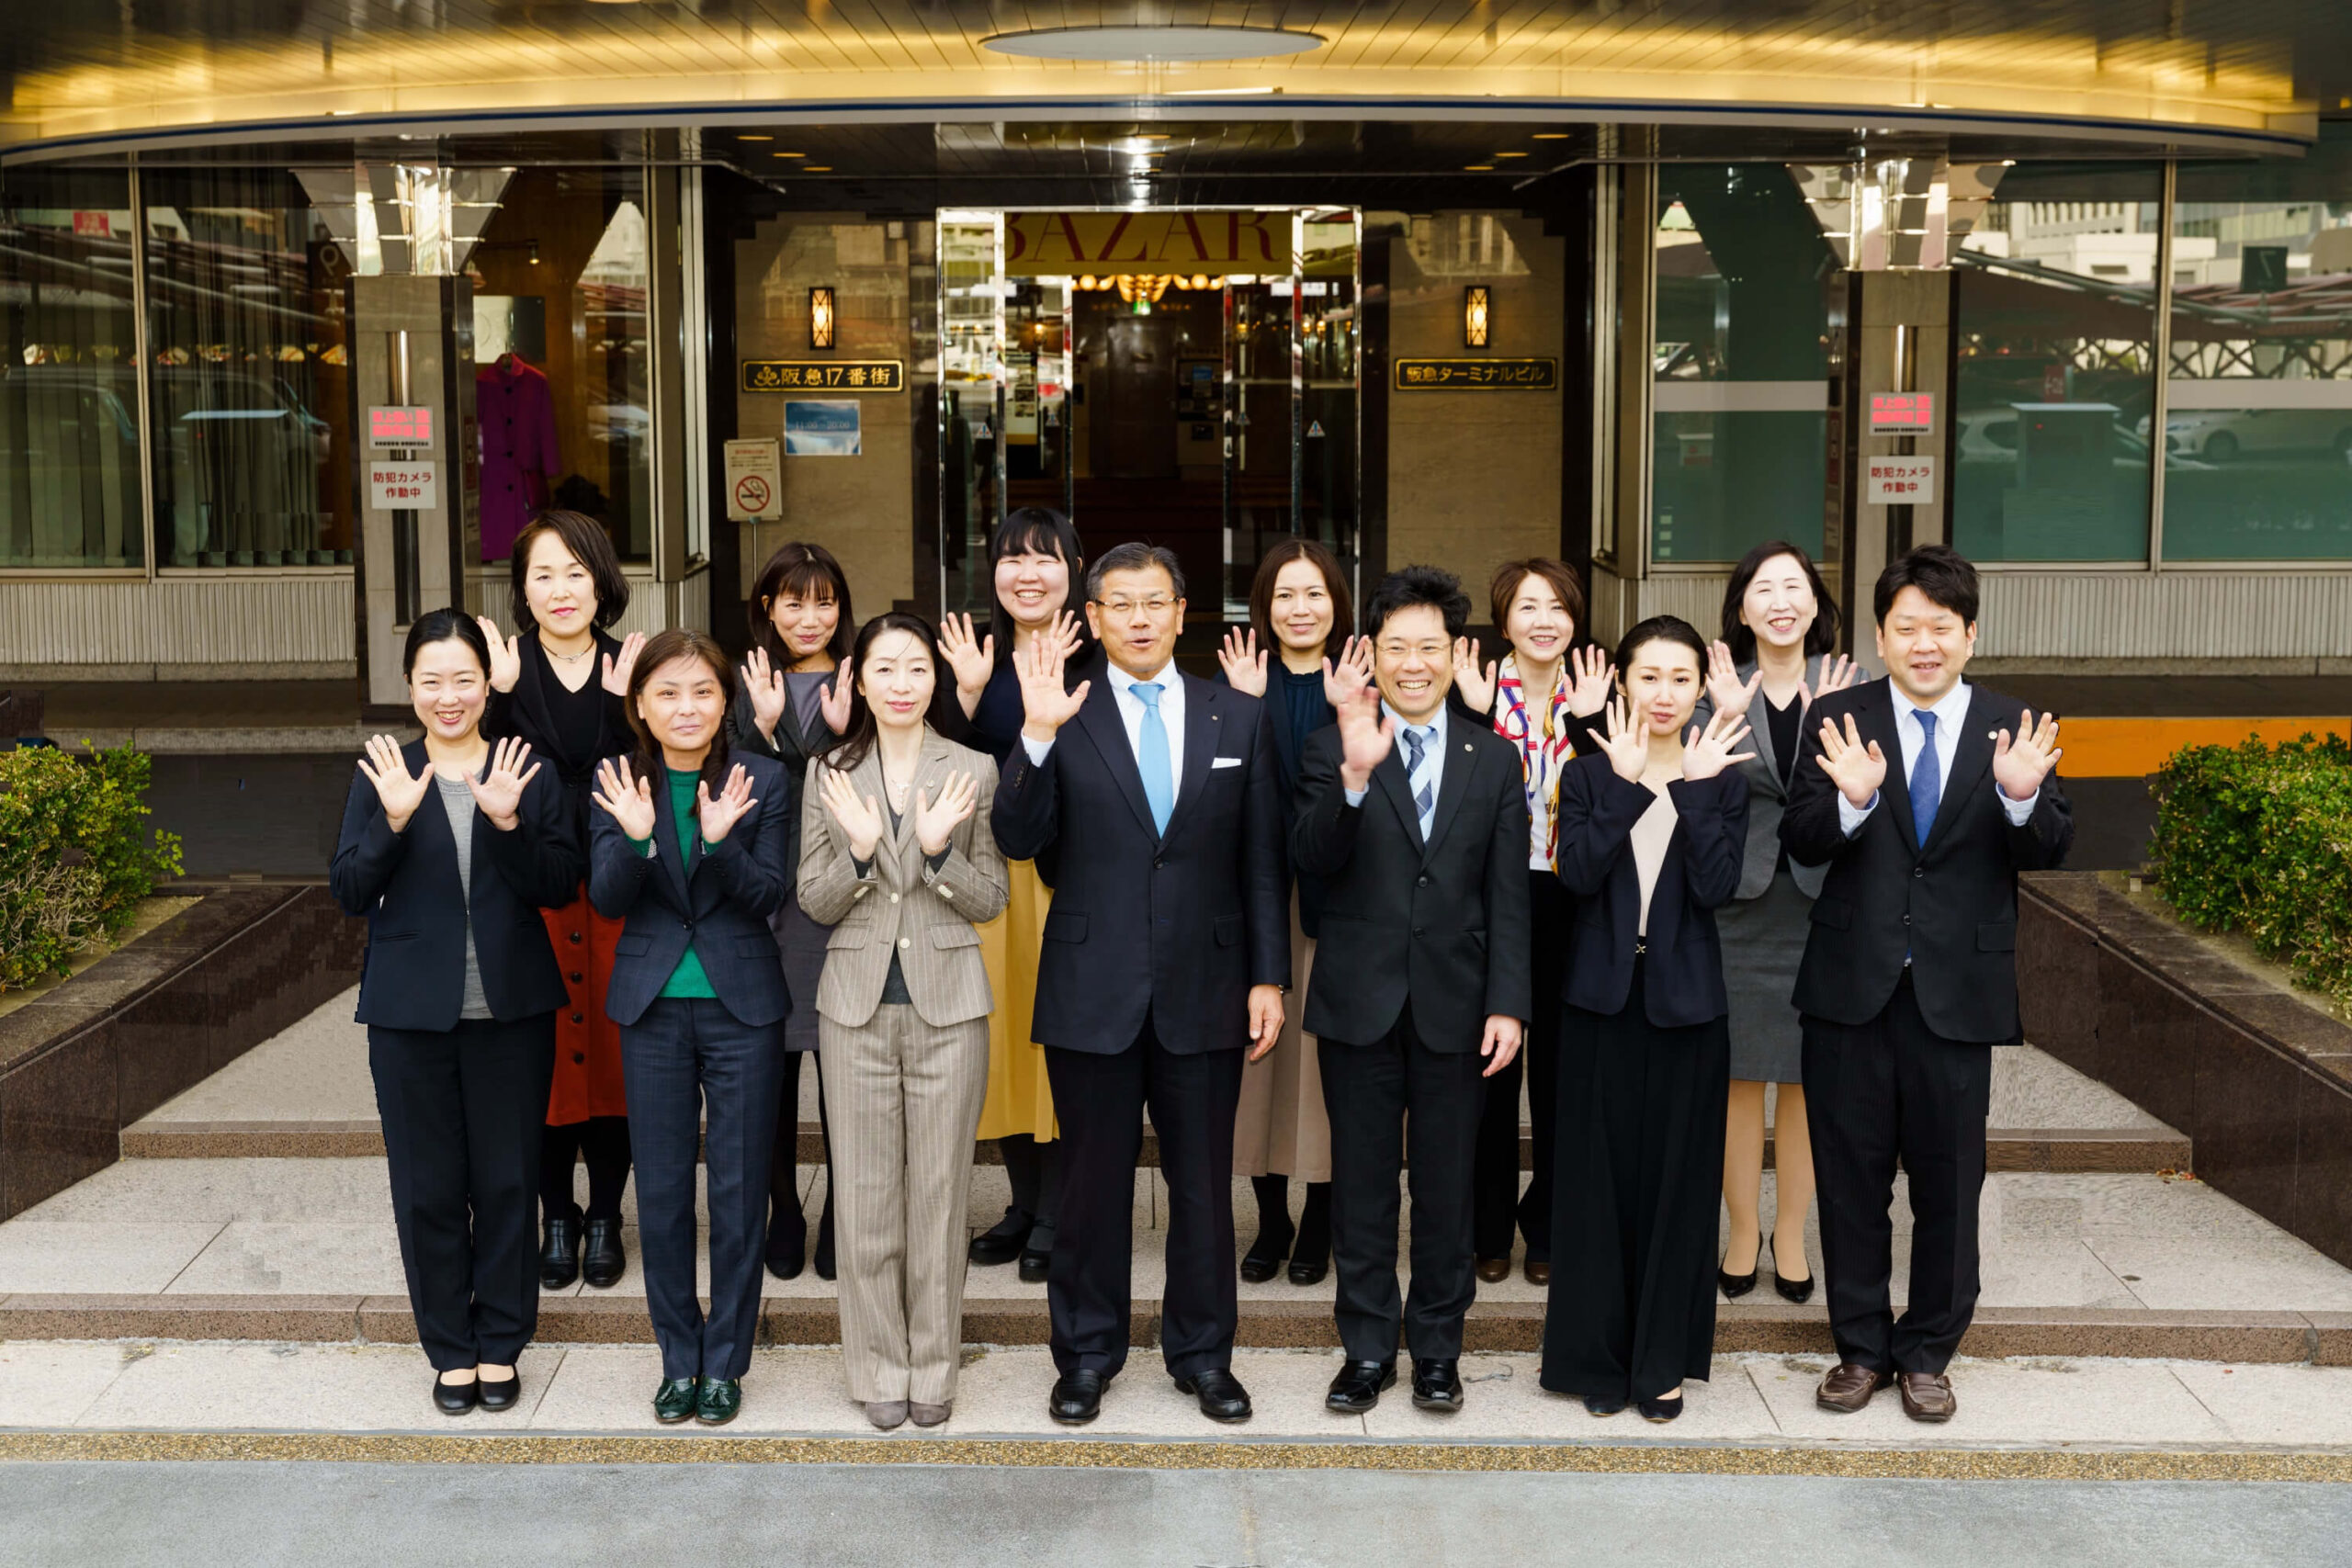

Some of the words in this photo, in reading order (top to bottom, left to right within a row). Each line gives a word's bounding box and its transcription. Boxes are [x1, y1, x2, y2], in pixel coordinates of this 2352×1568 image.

[781, 367, 891, 387] 阪急17番街
[1406, 366, 1545, 383] 阪急ターミナルビル
[373, 471, 432, 483] 防犯カメラ
[1871, 466, 1930, 479] 防犯カメラ
[385, 487, 421, 499] 作動中
[1883, 481, 1918, 493] 作動中
